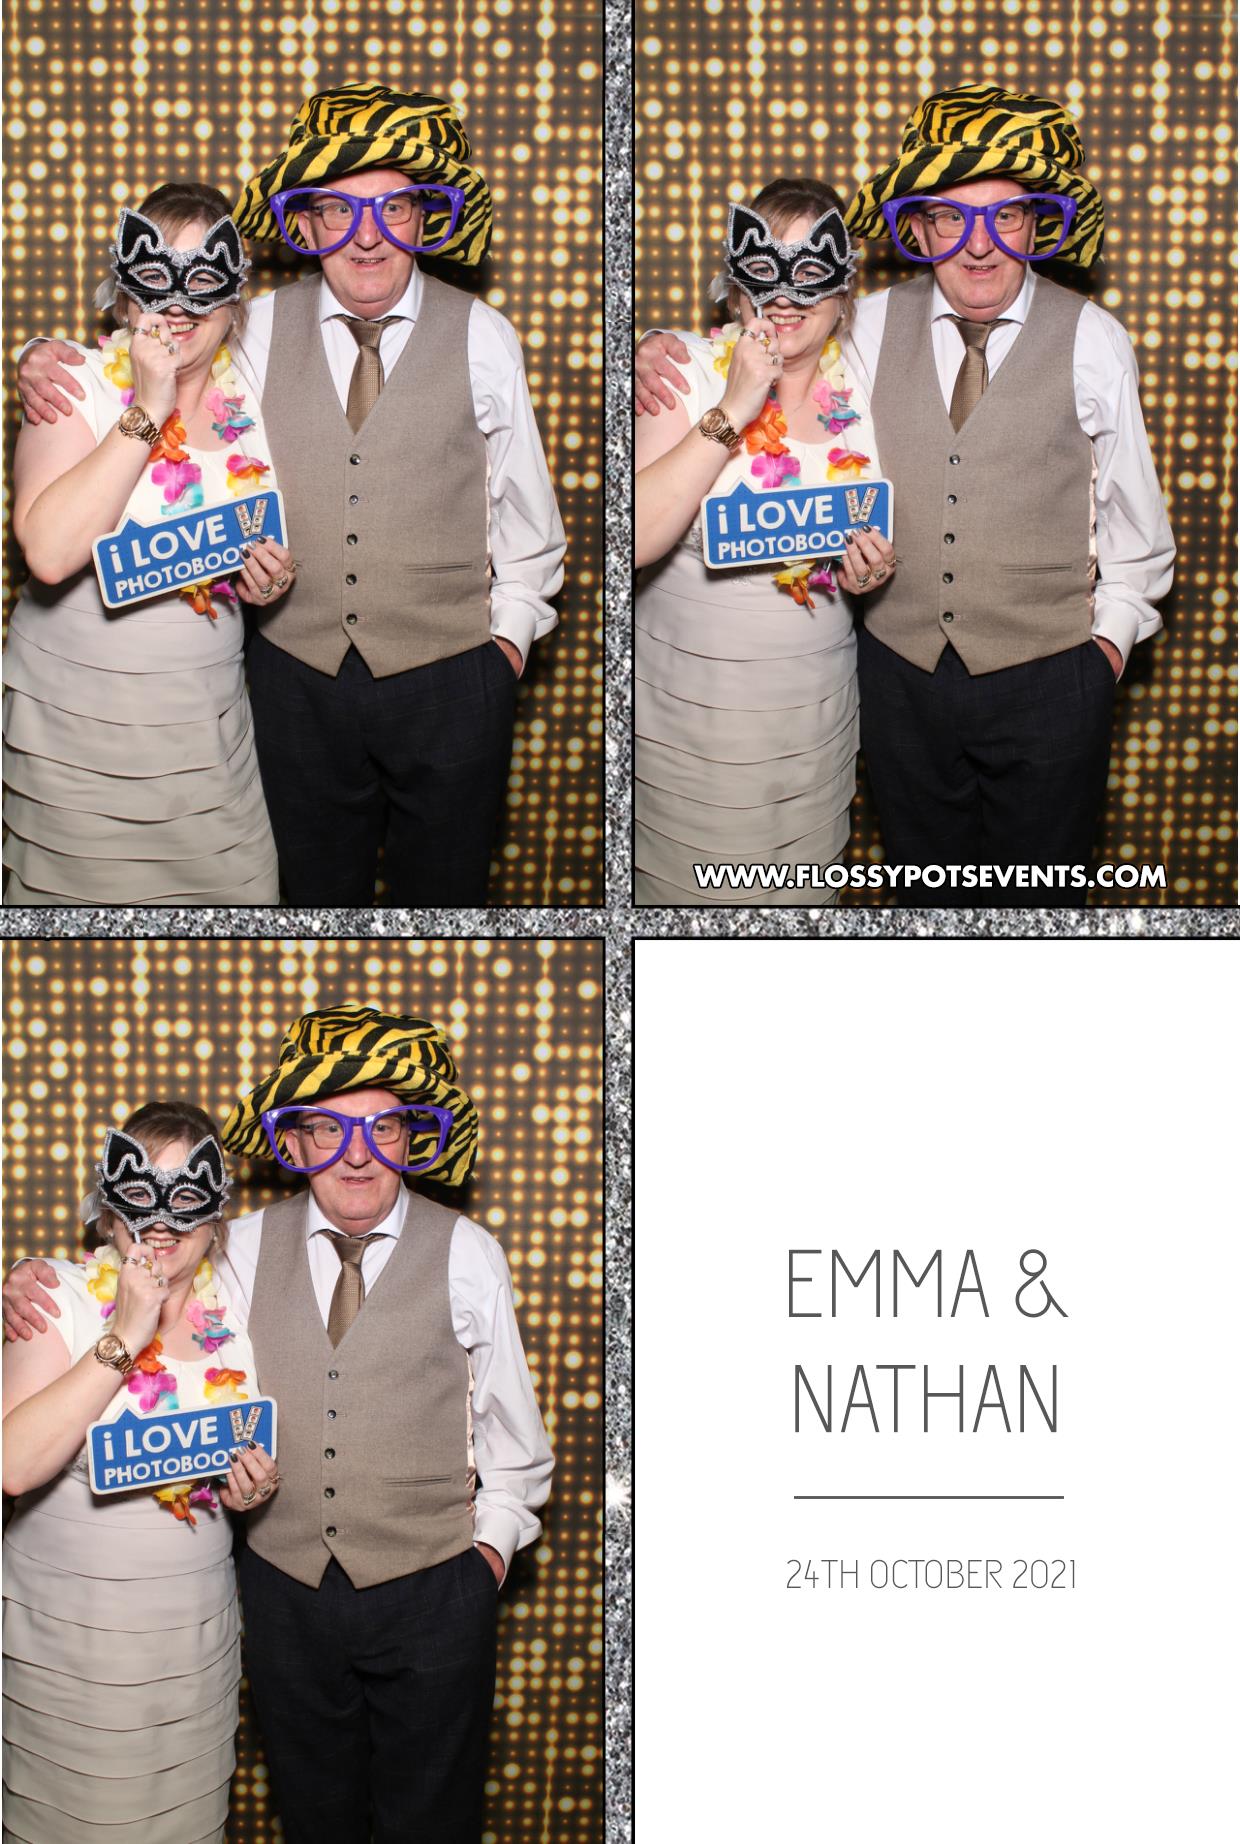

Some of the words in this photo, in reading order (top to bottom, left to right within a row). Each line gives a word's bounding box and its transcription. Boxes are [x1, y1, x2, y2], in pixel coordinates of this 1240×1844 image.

[717, 504, 729, 535] i
[739, 495, 834, 533] LOVE
[109, 540, 124, 574] i
[131, 514, 227, 568] LOVE
[103, 1431, 114, 1461] i
[124, 1416, 218, 1457] LOVE
